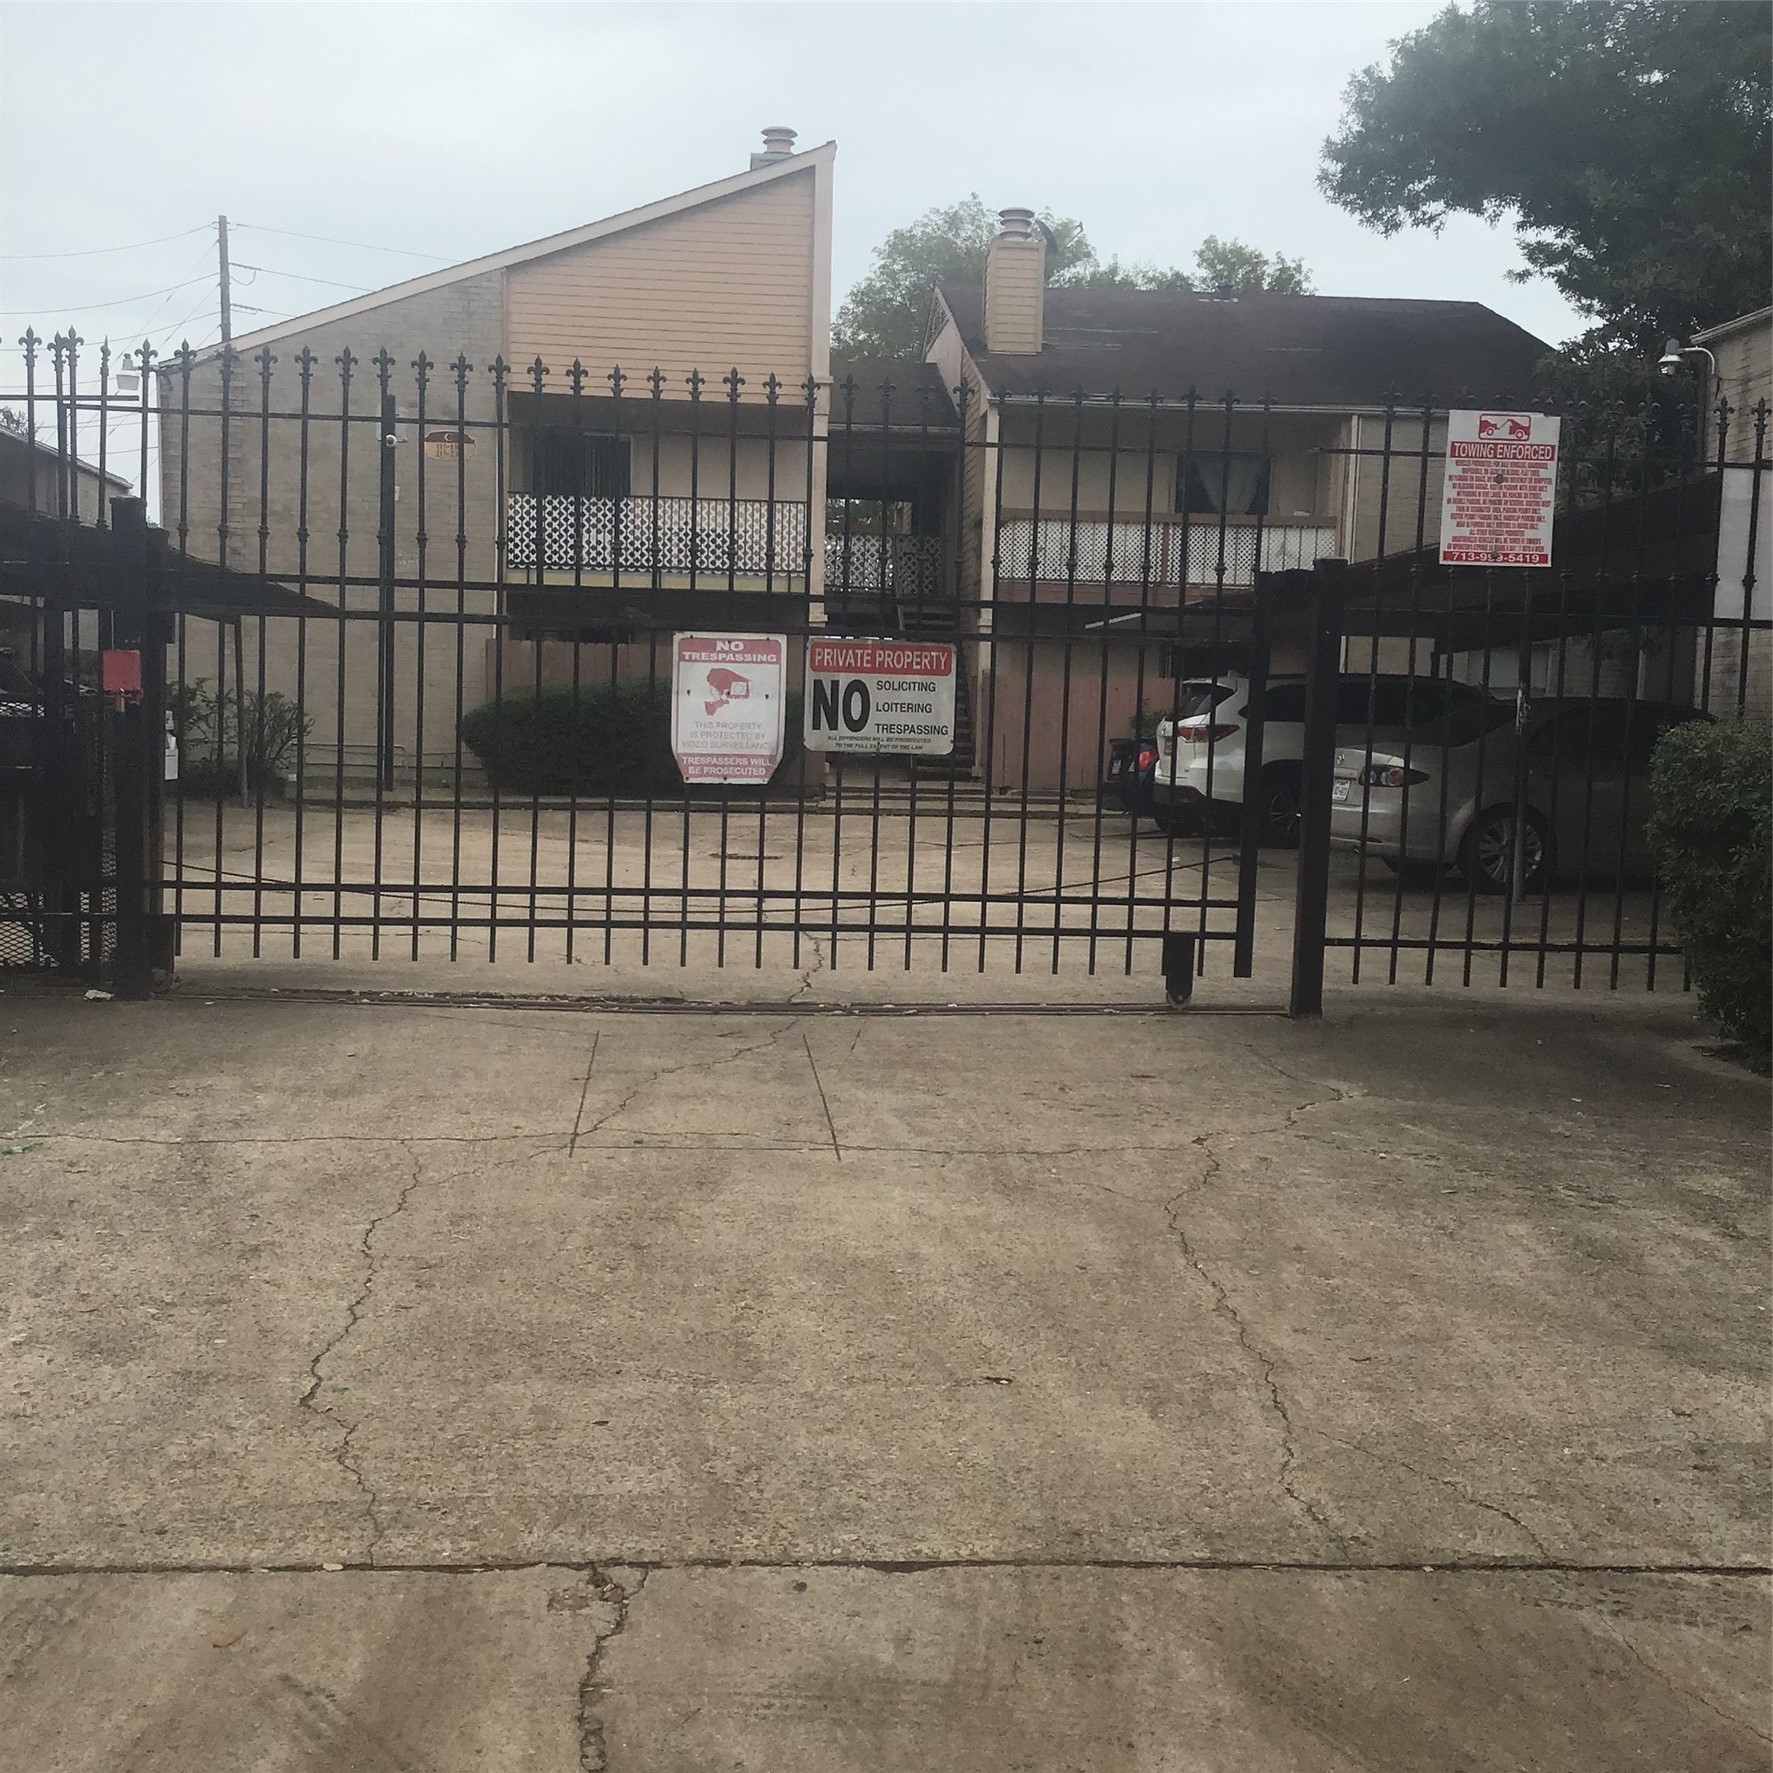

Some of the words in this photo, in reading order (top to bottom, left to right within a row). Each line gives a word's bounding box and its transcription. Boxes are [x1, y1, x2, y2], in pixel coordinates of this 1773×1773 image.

[1454, 443, 1494, 458] TOWING
[1496, 444, 1552, 460] ENFORCED
[716, 641, 744, 652] NO
[682, 652, 777, 662] TRESPASSING
[815, 648, 872, 668] PRIVATE
[876, 650, 948, 670] PROPERTY
[876, 680, 936, 692] SOLICITING
[812, 679, 870, 732] NO
[876, 702, 932, 713] LOITERING
[695, 722, 714, 730] THIS
[716, 722, 762, 730] PROPERTY
[875, 724, 948, 736] TRESPASSING
[702, 731, 752, 739] PROTECTED
[682, 740, 708, 748] VIDEO
[682, 756, 748, 766] TRESPASSERS
[750, 758, 772, 766] WILL
[688, 766, 701, 774] BE
[704, 766, 766, 775] PROSECUTED
